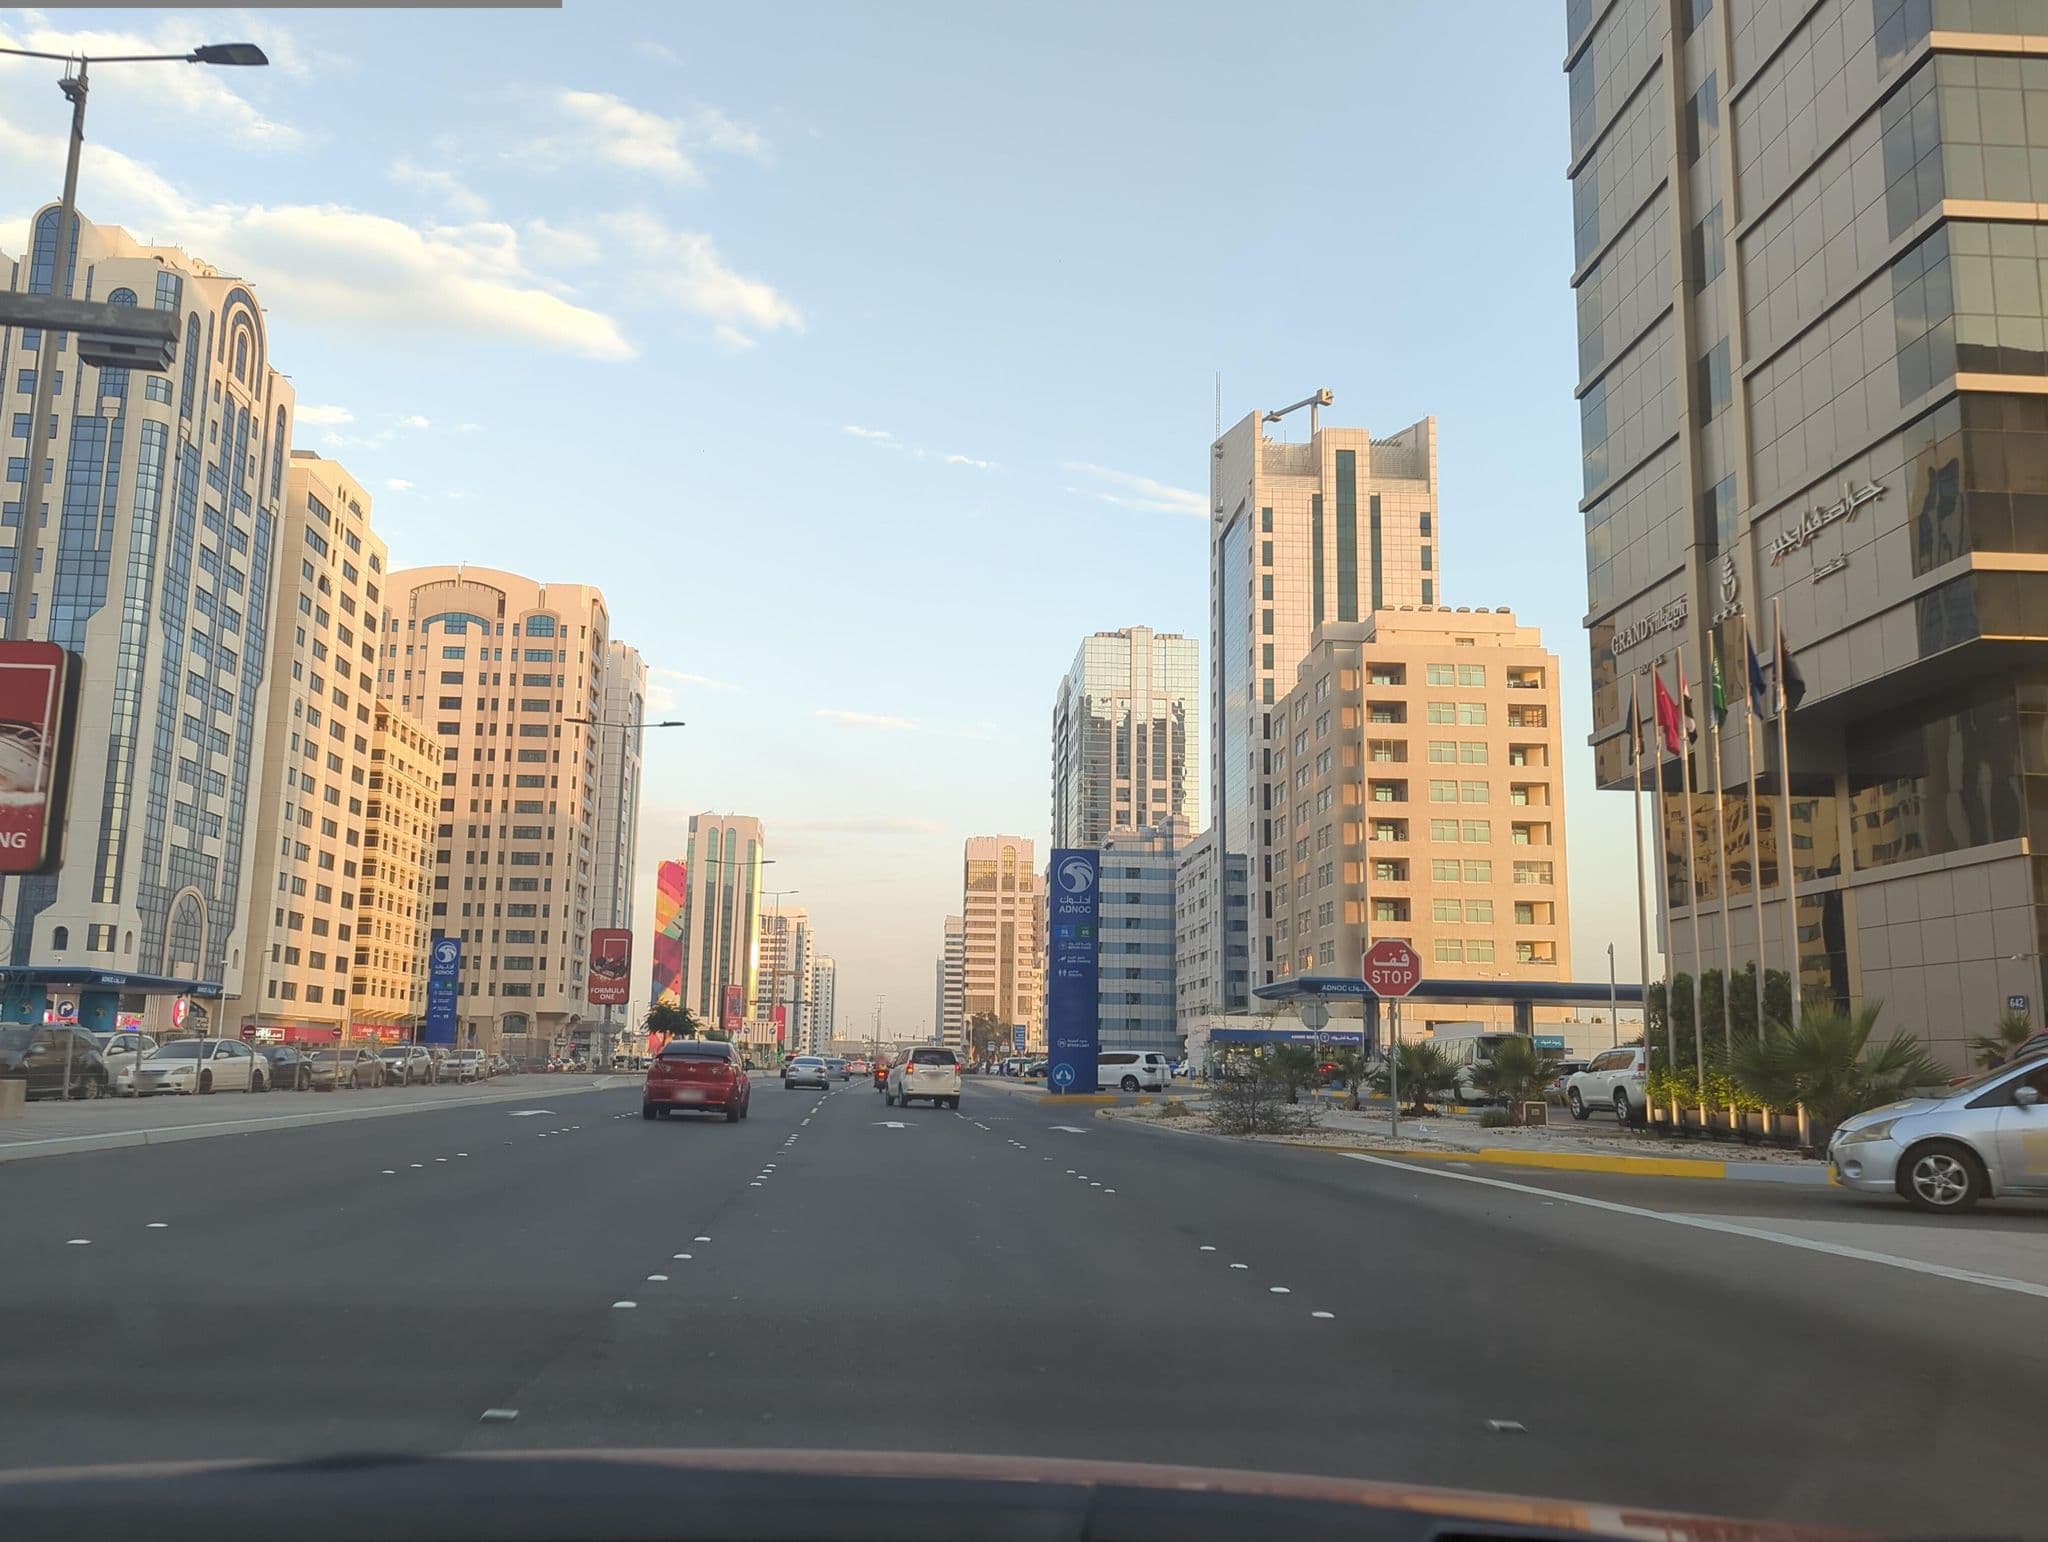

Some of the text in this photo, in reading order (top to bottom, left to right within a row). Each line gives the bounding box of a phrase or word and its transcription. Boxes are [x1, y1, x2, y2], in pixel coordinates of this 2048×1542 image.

[1058, 905, 1092, 914] ADNOC
[1372, 949, 1410, 967] قف
[1371, 970, 1412, 985] STOP
[1321, 983, 1347, 992] ADNOC
